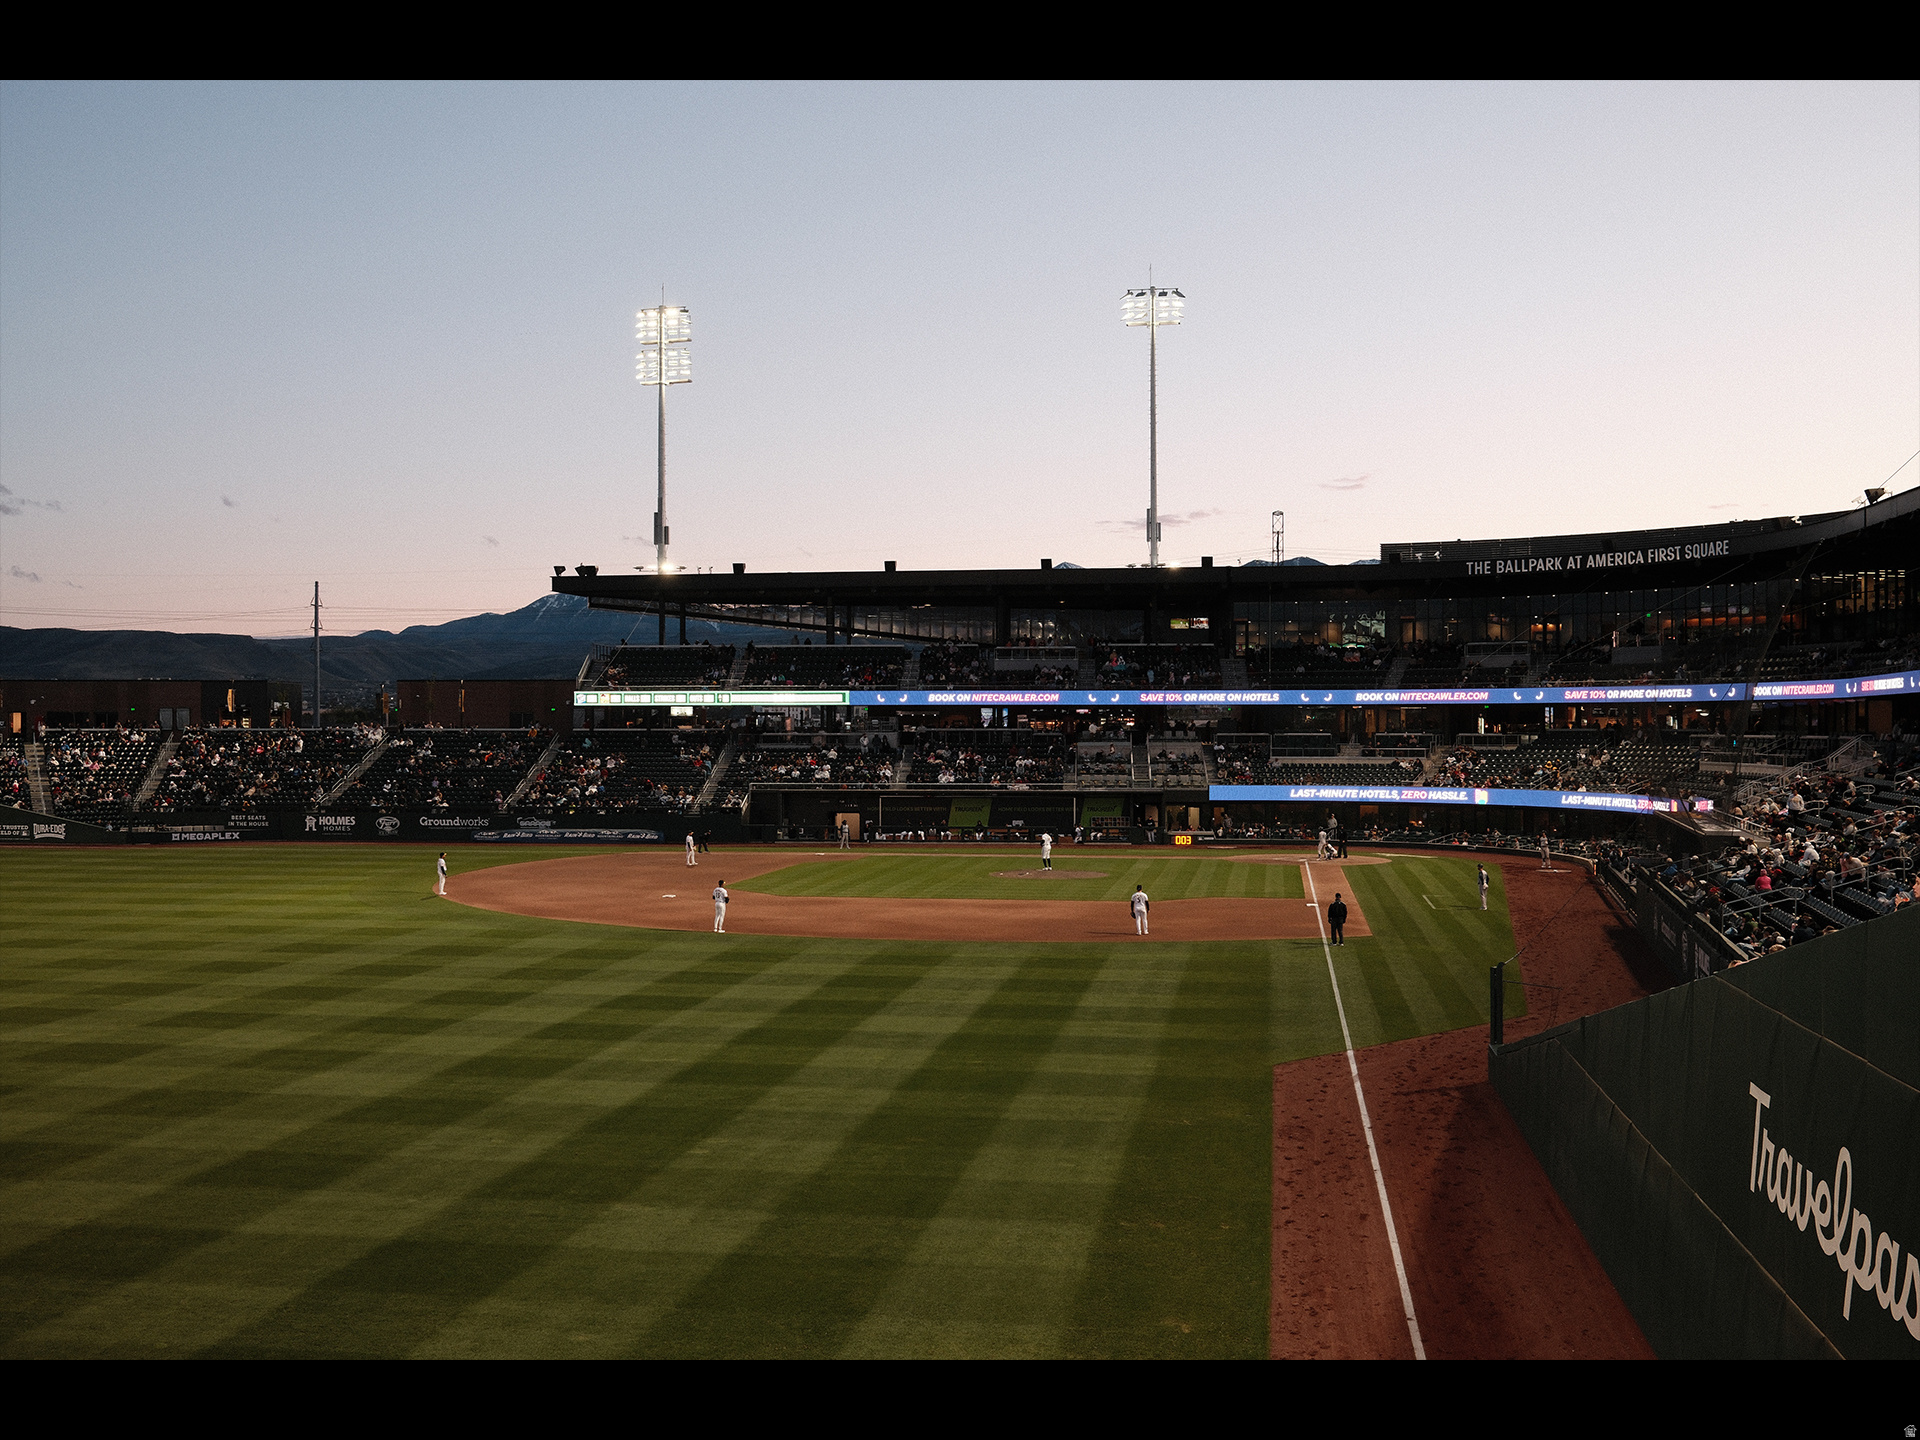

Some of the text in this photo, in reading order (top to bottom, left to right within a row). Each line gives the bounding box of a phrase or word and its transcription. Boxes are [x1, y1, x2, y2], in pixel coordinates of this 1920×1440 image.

[1466, 540, 1729, 575] THE BALLPARK AT AMERICA FIRST SQUARE
[928, 693, 1059, 702] BOOK ON NITECRAWLER.COM
[1140, 693, 1279, 702] SAVE 10% OR MORE ON HOTELS
[1355, 692, 1488, 702] BOOK ON NITECRAWLER.COM
[1564, 688, 1692, 699] SAVE 10% OR MORE ON HOTELS
[1290, 789, 1468, 800] LAST-MINUTE HOTELS, ZERO HASSLE.
[1562, 795, 1612, 806] LAST-MINUTE
[319, 816, 356, 826] HOLMES
[419, 816, 489, 827] Groundworks
[181, 832, 240, 841] MEGAPLEX
[1175, 835, 1192, 845] 003
